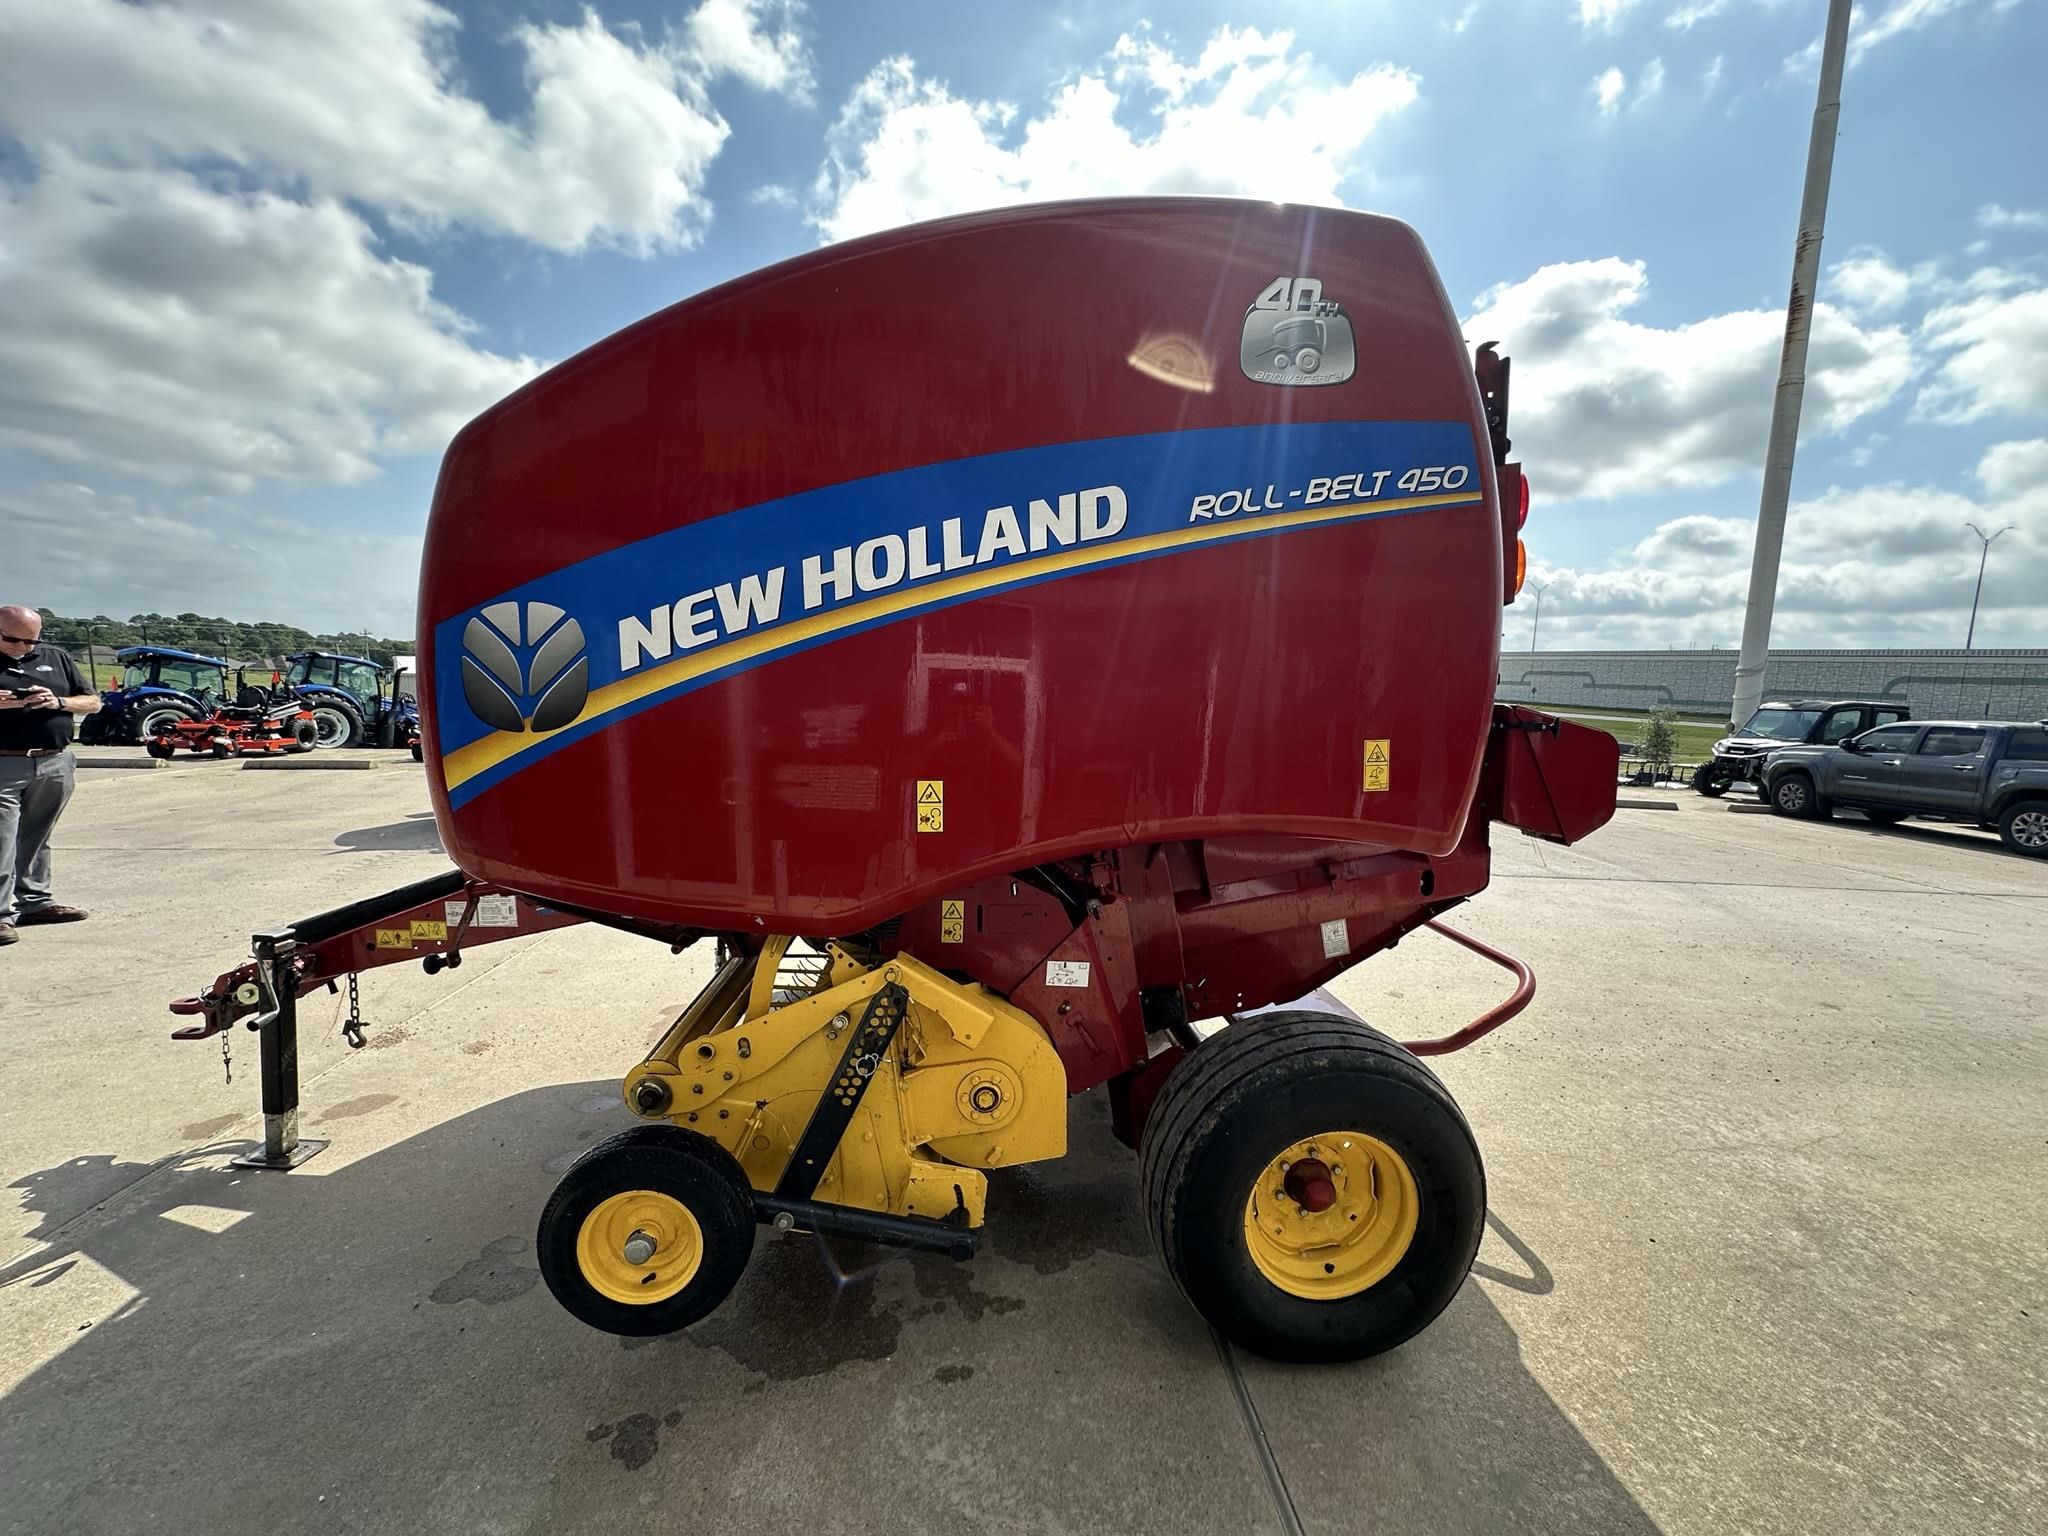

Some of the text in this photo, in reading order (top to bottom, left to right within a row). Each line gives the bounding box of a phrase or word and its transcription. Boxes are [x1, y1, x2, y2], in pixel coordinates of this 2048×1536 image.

[1397, 465, 1470, 492] 450
[617, 485, 1128, 672] NEW HOLLAND
